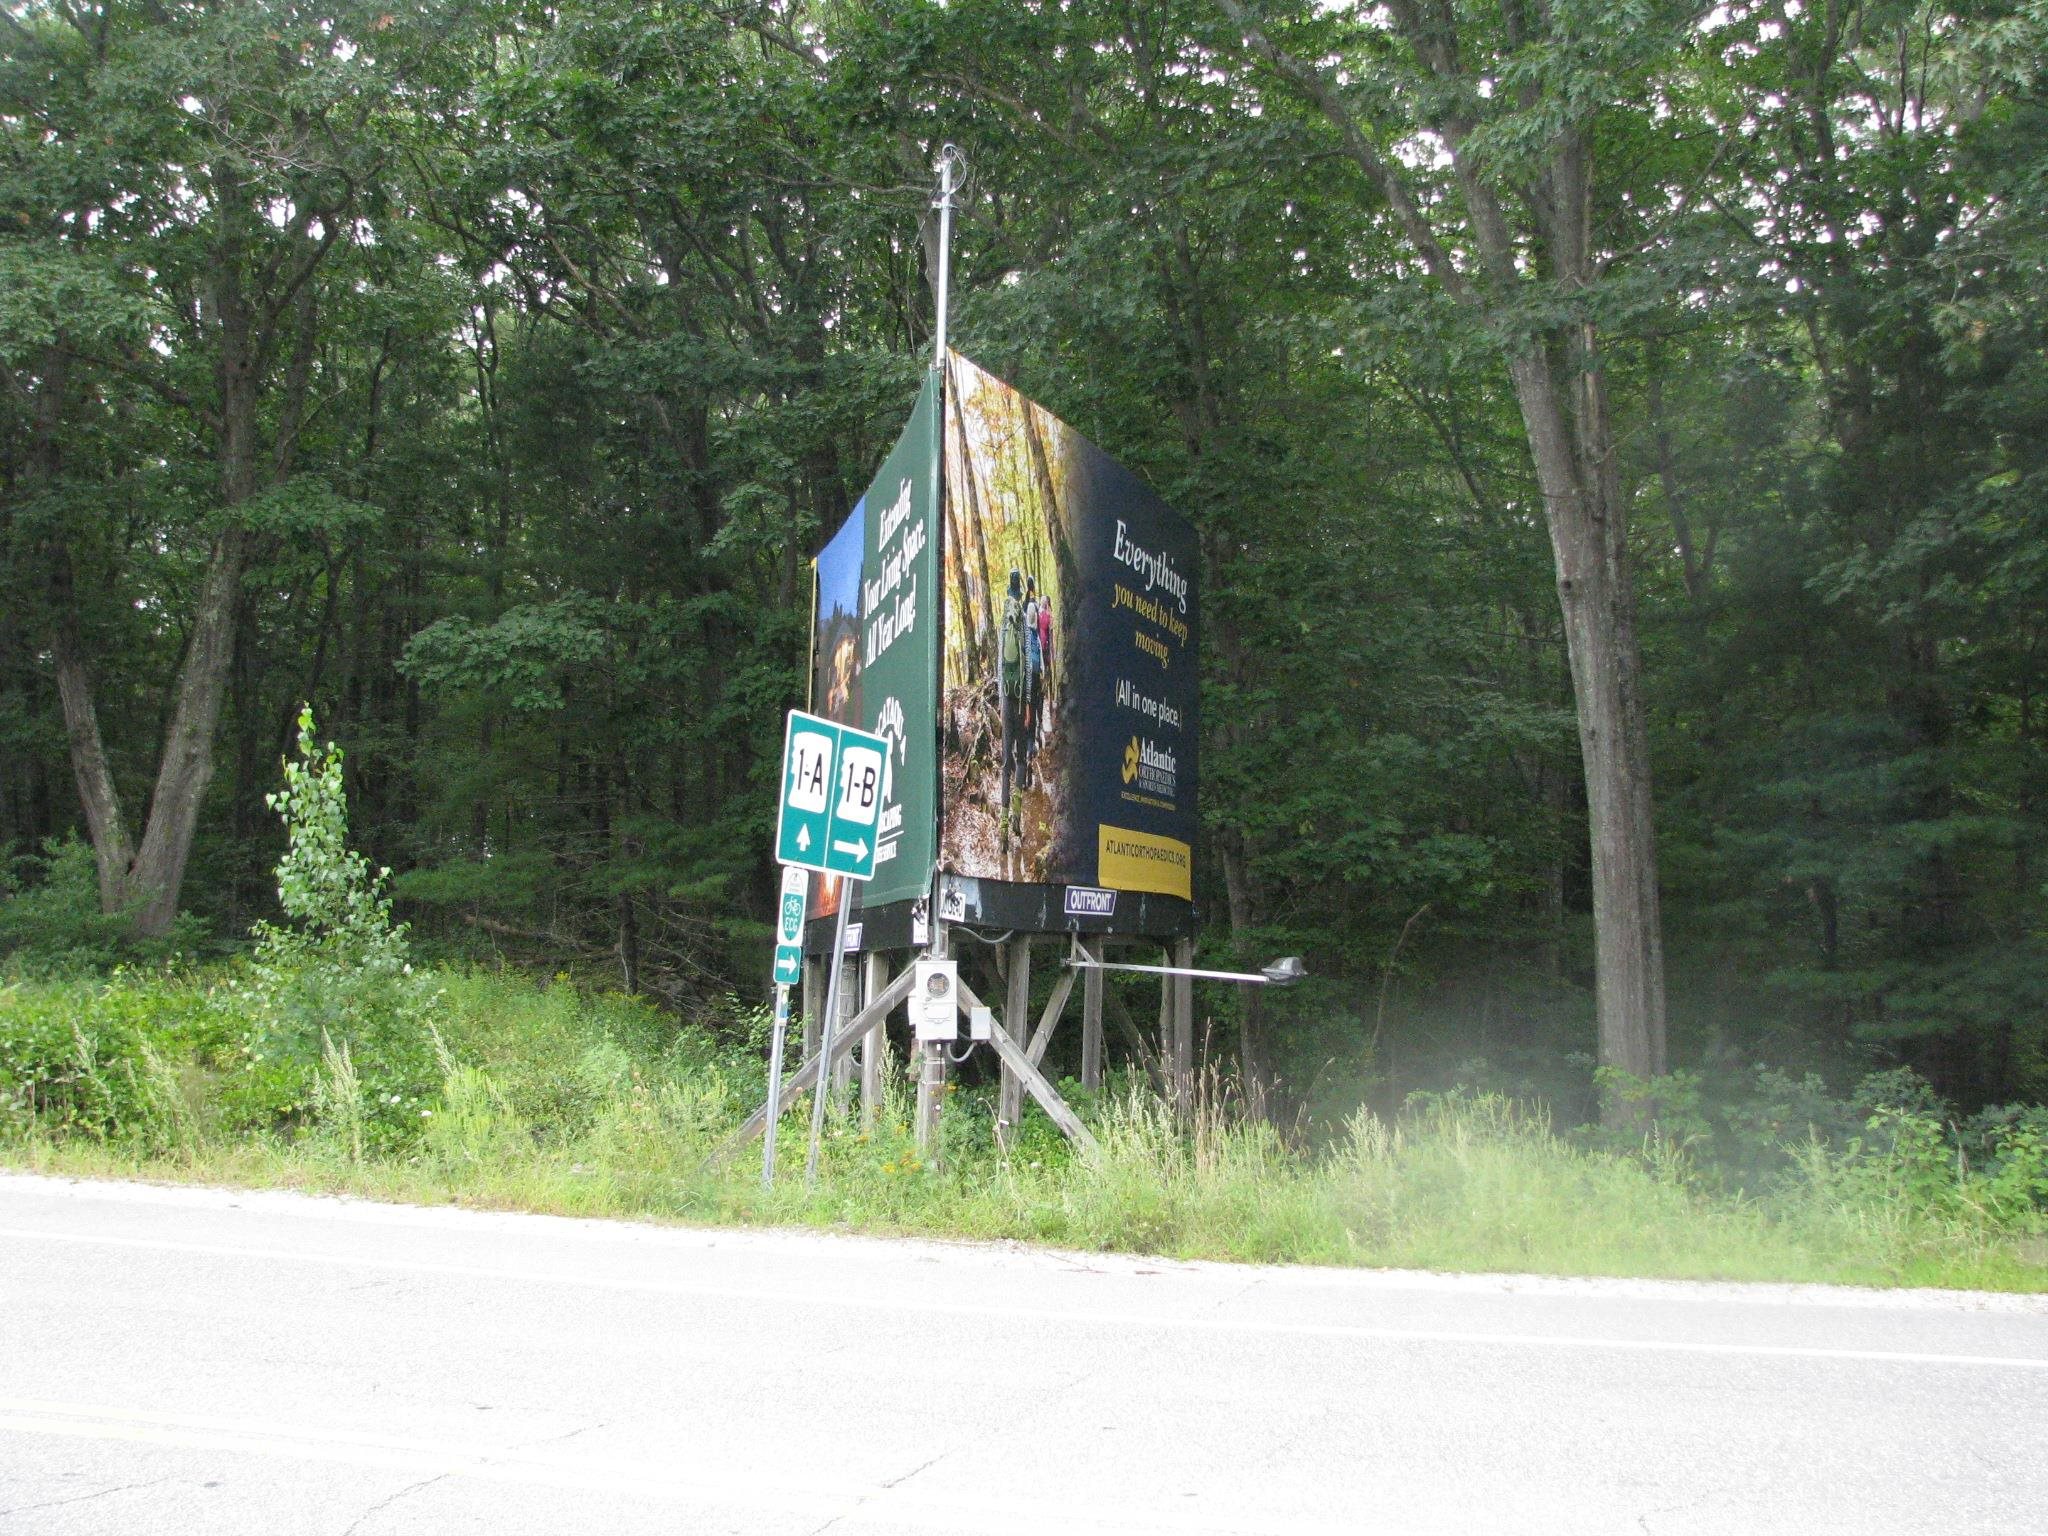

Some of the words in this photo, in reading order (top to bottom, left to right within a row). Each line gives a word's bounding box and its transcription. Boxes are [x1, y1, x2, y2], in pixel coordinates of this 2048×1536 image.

[878, 478, 912, 553] Extending
[863, 579, 881, 620] Your
[880, 546, 902, 601] Living
[902, 518, 926, 578] Space.
[1113, 519, 1188, 615] Everything
[865, 628, 878, 669] All
[878, 612, 894, 656] Year
[895, 573, 916, 638] Long!
[1112, 582, 1134, 609] you
[1135, 593, 1157, 623] need
[1159, 602, 1168, 628] to
[1168, 607, 1188, 648] keep
[1135, 630, 1170, 669] moving.
[1116, 677, 1130, 706] (All
[1132, 685, 1140, 711] in
[1141, 695, 1157, 718] one
[1139, 736, 1176, 774] Atlantic
[785, 917, 798, 932] ECG
[1070, 890, 1113, 912] OUTFRONT
